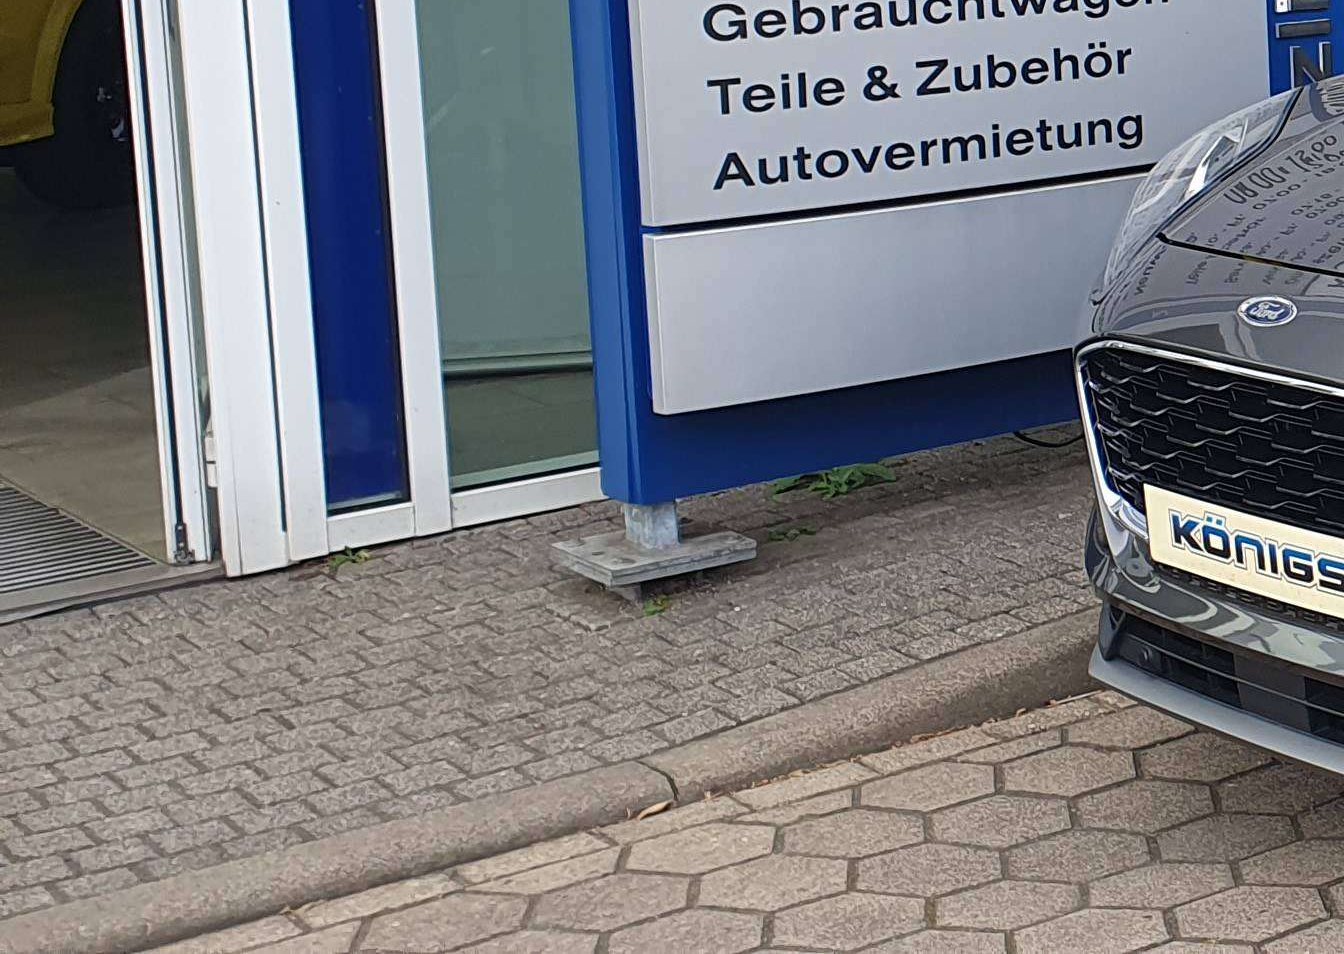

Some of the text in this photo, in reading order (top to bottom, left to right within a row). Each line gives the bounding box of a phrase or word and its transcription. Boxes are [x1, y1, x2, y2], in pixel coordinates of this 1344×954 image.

[706, 41, 1132, 115] Teile & Zubehör
[713, 112, 1146, 191] Autovermietung
[1248, 300, 1286, 321] Ford
